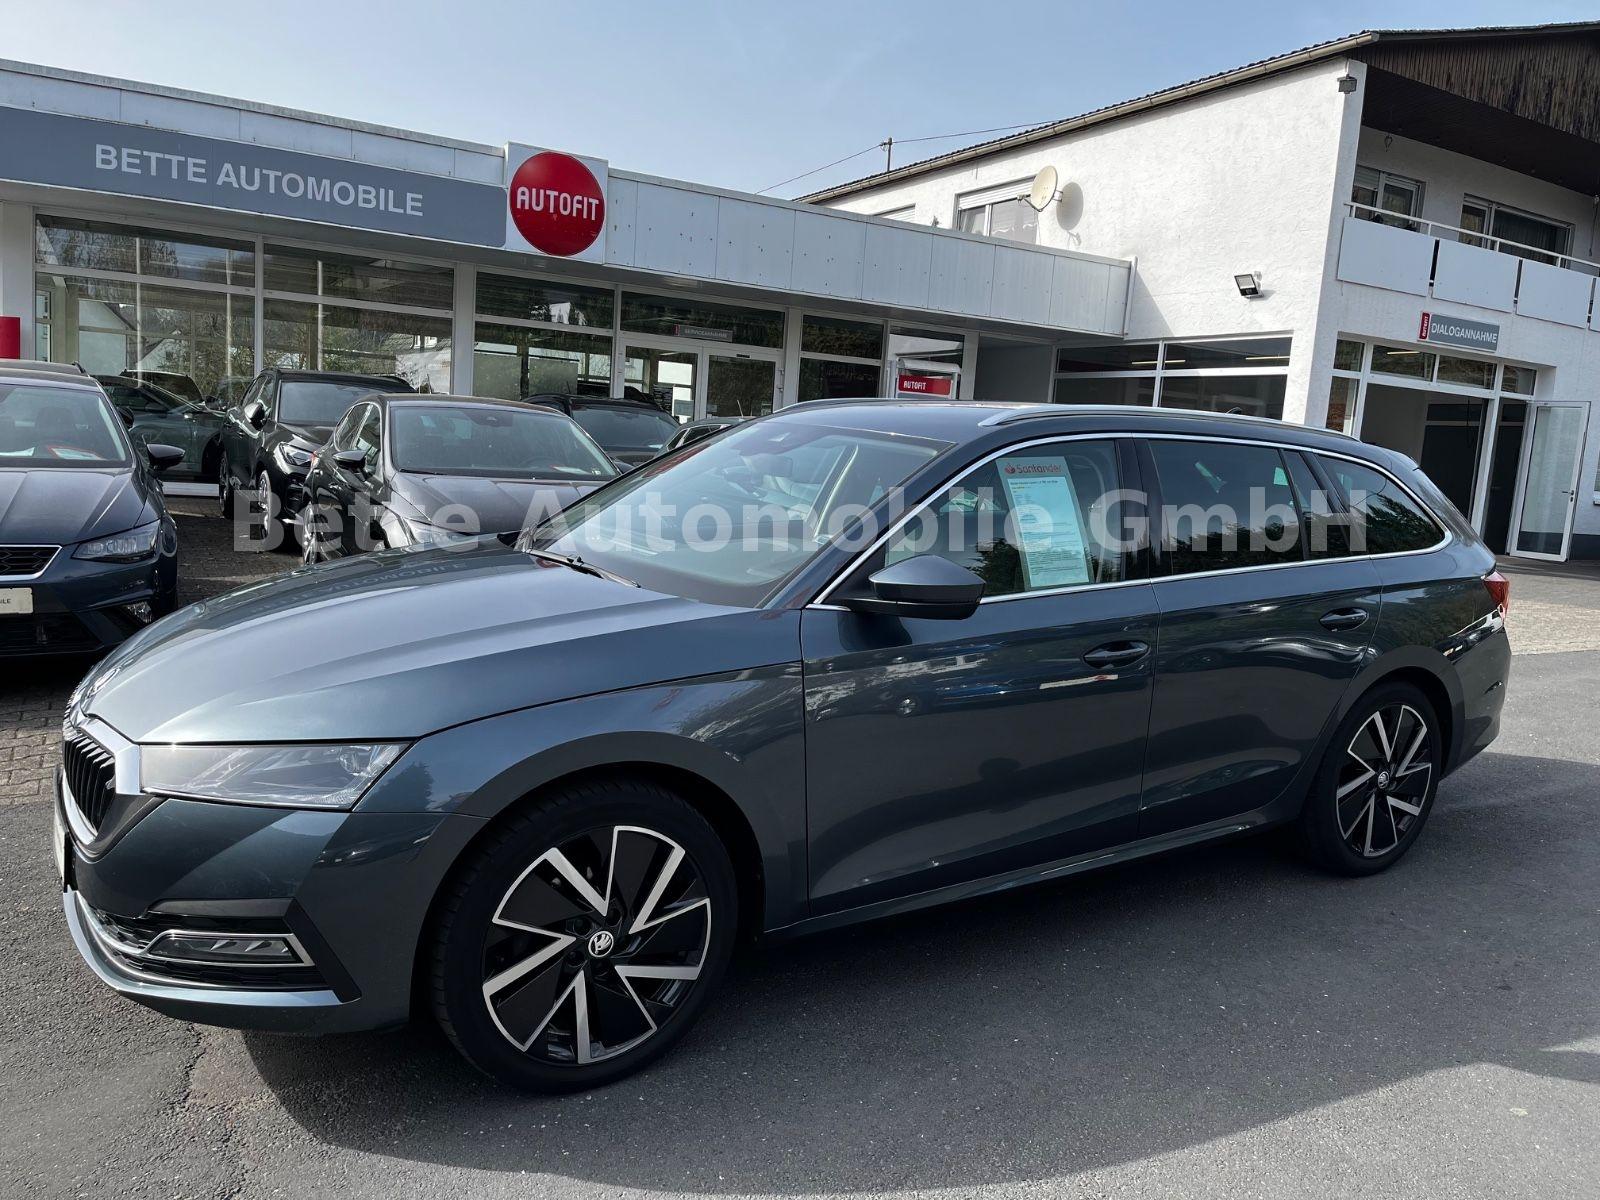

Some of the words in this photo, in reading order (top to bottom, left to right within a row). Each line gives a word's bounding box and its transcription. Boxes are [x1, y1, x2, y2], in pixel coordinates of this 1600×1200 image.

[95, 144, 207, 184] BETTE
[216, 162, 424, 217] AUTOMOBILE
[516, 186, 600, 221] AUTOFIT
[1431, 323, 1498, 343] DIALOGANNAHME
[903, 380, 927, 391] AUTOFIT
[1015, 463, 1063, 474] Santander
